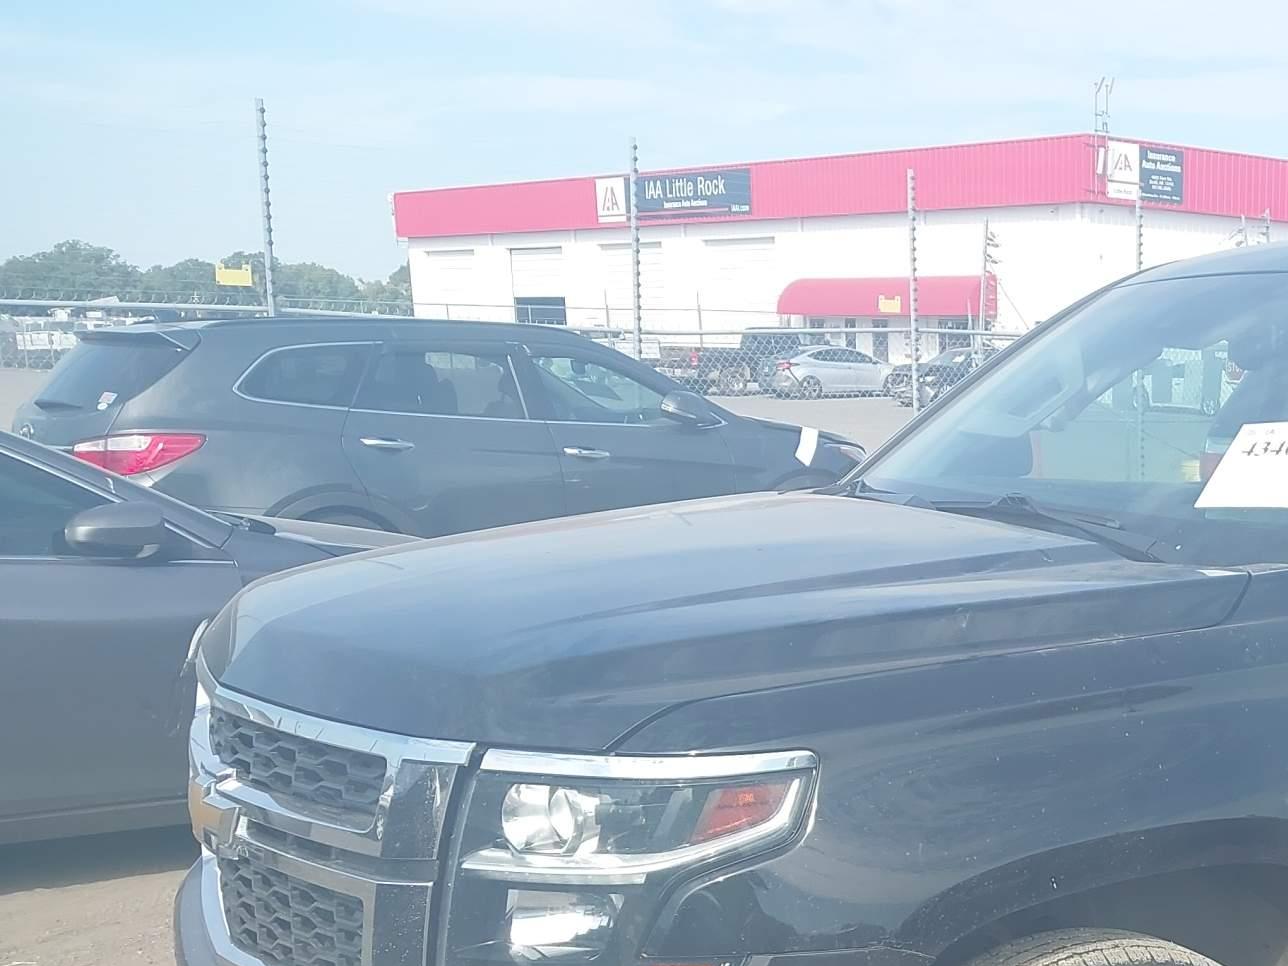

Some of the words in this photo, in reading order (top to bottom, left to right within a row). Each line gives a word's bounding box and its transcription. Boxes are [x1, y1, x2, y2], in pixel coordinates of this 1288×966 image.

[1142, 160, 1155, 169] Auto
[1157, 161, 1181, 173] Auctions
[645, 181, 663, 199] IAA
[666, 178, 693, 198] Little
[698, 175, 726, 196] Rock
